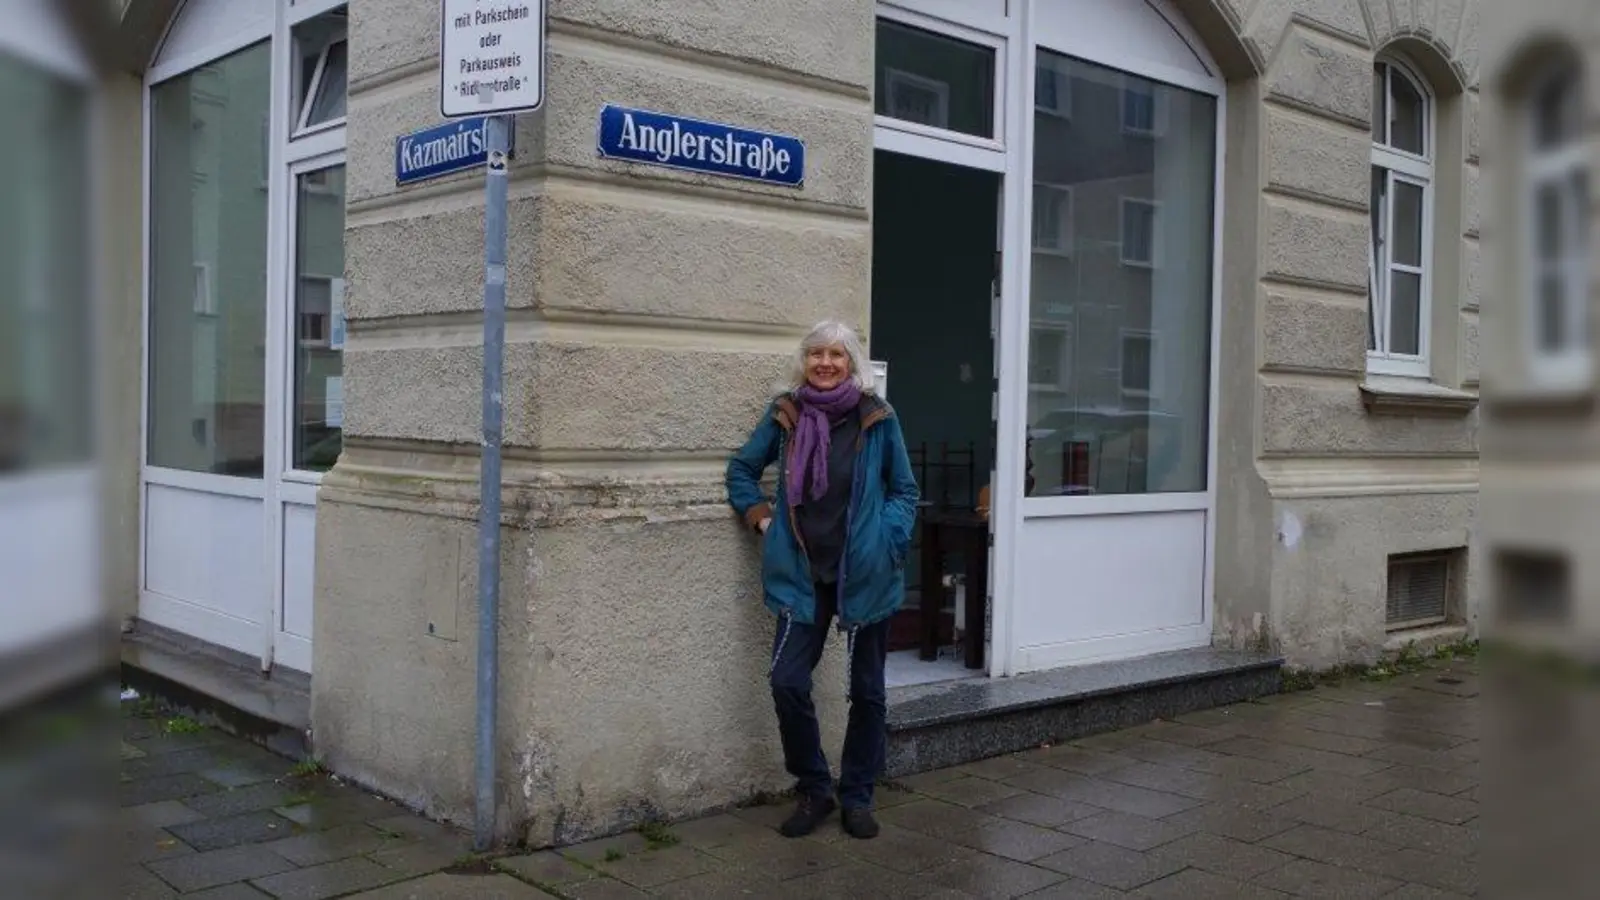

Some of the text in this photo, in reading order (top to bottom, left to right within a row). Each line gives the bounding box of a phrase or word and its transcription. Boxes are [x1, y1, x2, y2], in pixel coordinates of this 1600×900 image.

[455, 5, 529, 29] mit Parkschein
[479, 32, 502, 48] oder
[460, 52, 521, 73] Parkausweis
[619, 113, 791, 177] Anglerstraße
